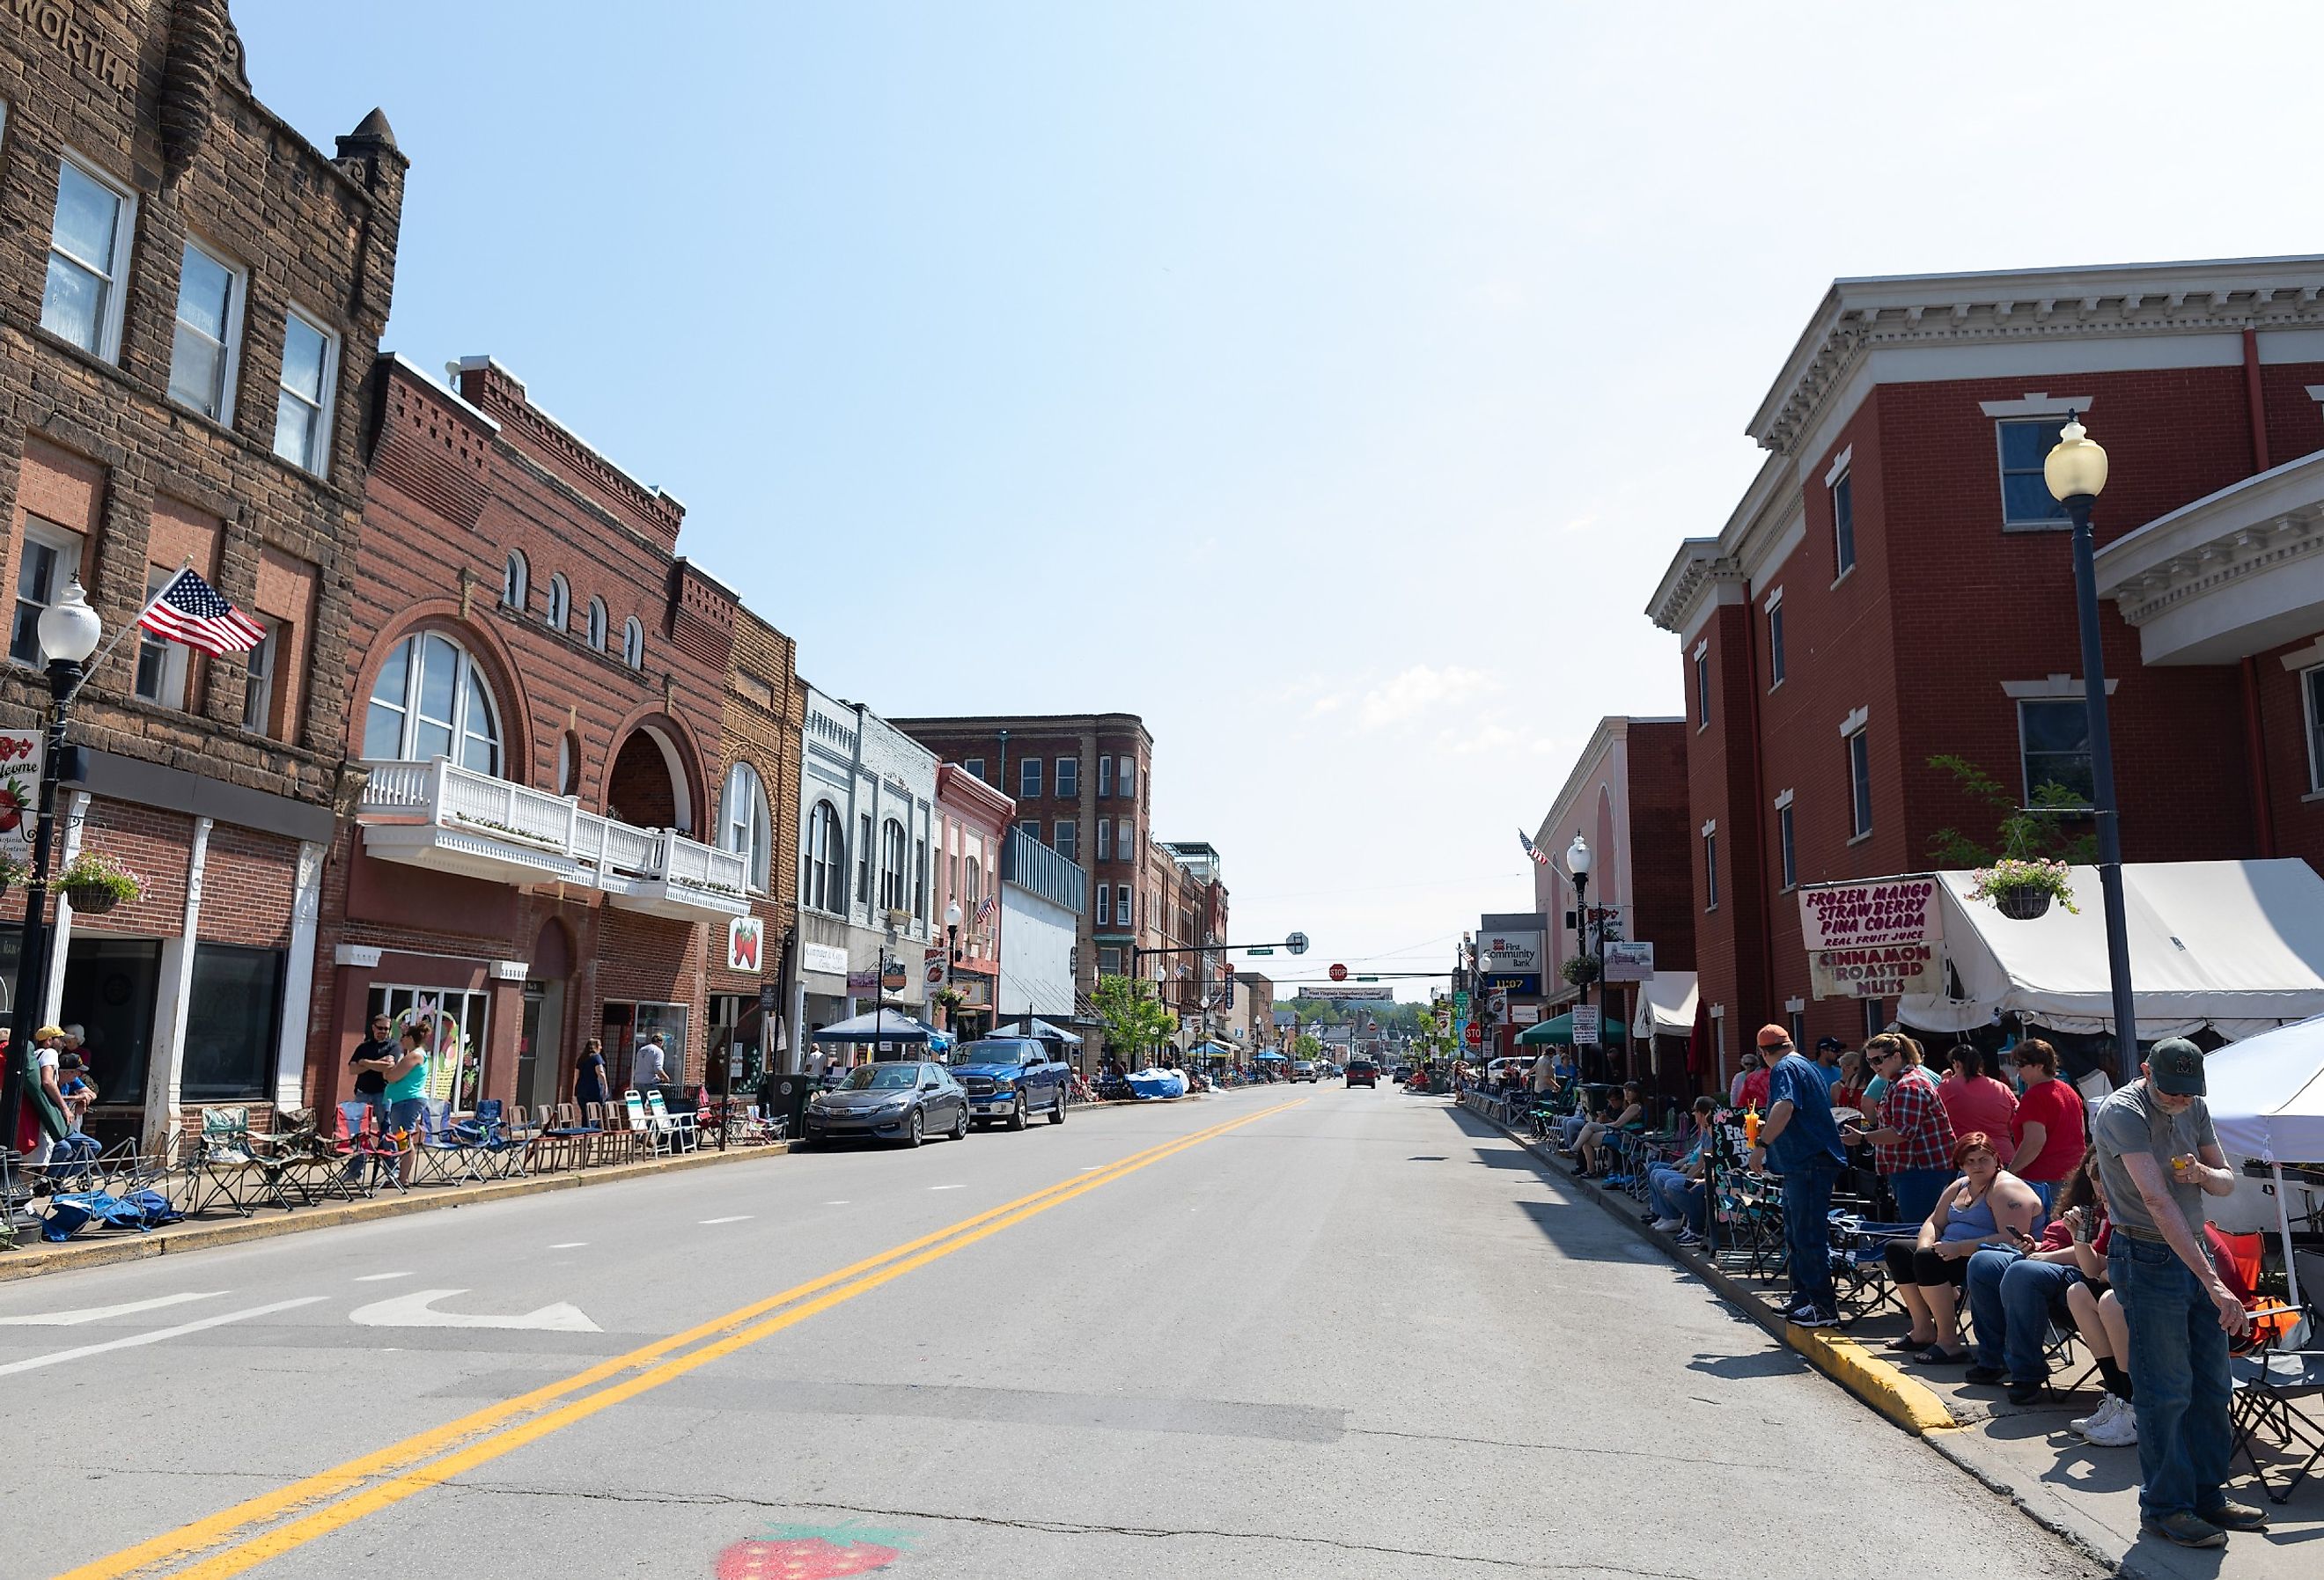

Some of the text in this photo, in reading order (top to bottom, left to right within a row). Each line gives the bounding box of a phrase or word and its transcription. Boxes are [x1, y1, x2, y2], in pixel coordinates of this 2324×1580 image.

[1806, 883, 1932, 908] FROZEN MANGO
[1817, 898, 1927, 922] STRAWBERRY
[1820, 912, 1925, 936] PINA COLADA
[1824, 930, 1924, 946] REAL FRUIT JUICE
[1484, 949, 1535, 961] Community
[1513, 959, 1531, 967] Bank
[1819, 945, 1931, 966] CINNAMON
[1835, 962, 1923, 981] ROASTED
[1856, 978, 1906, 996] NUTS
[1467, 1028, 1482, 1038] STO
